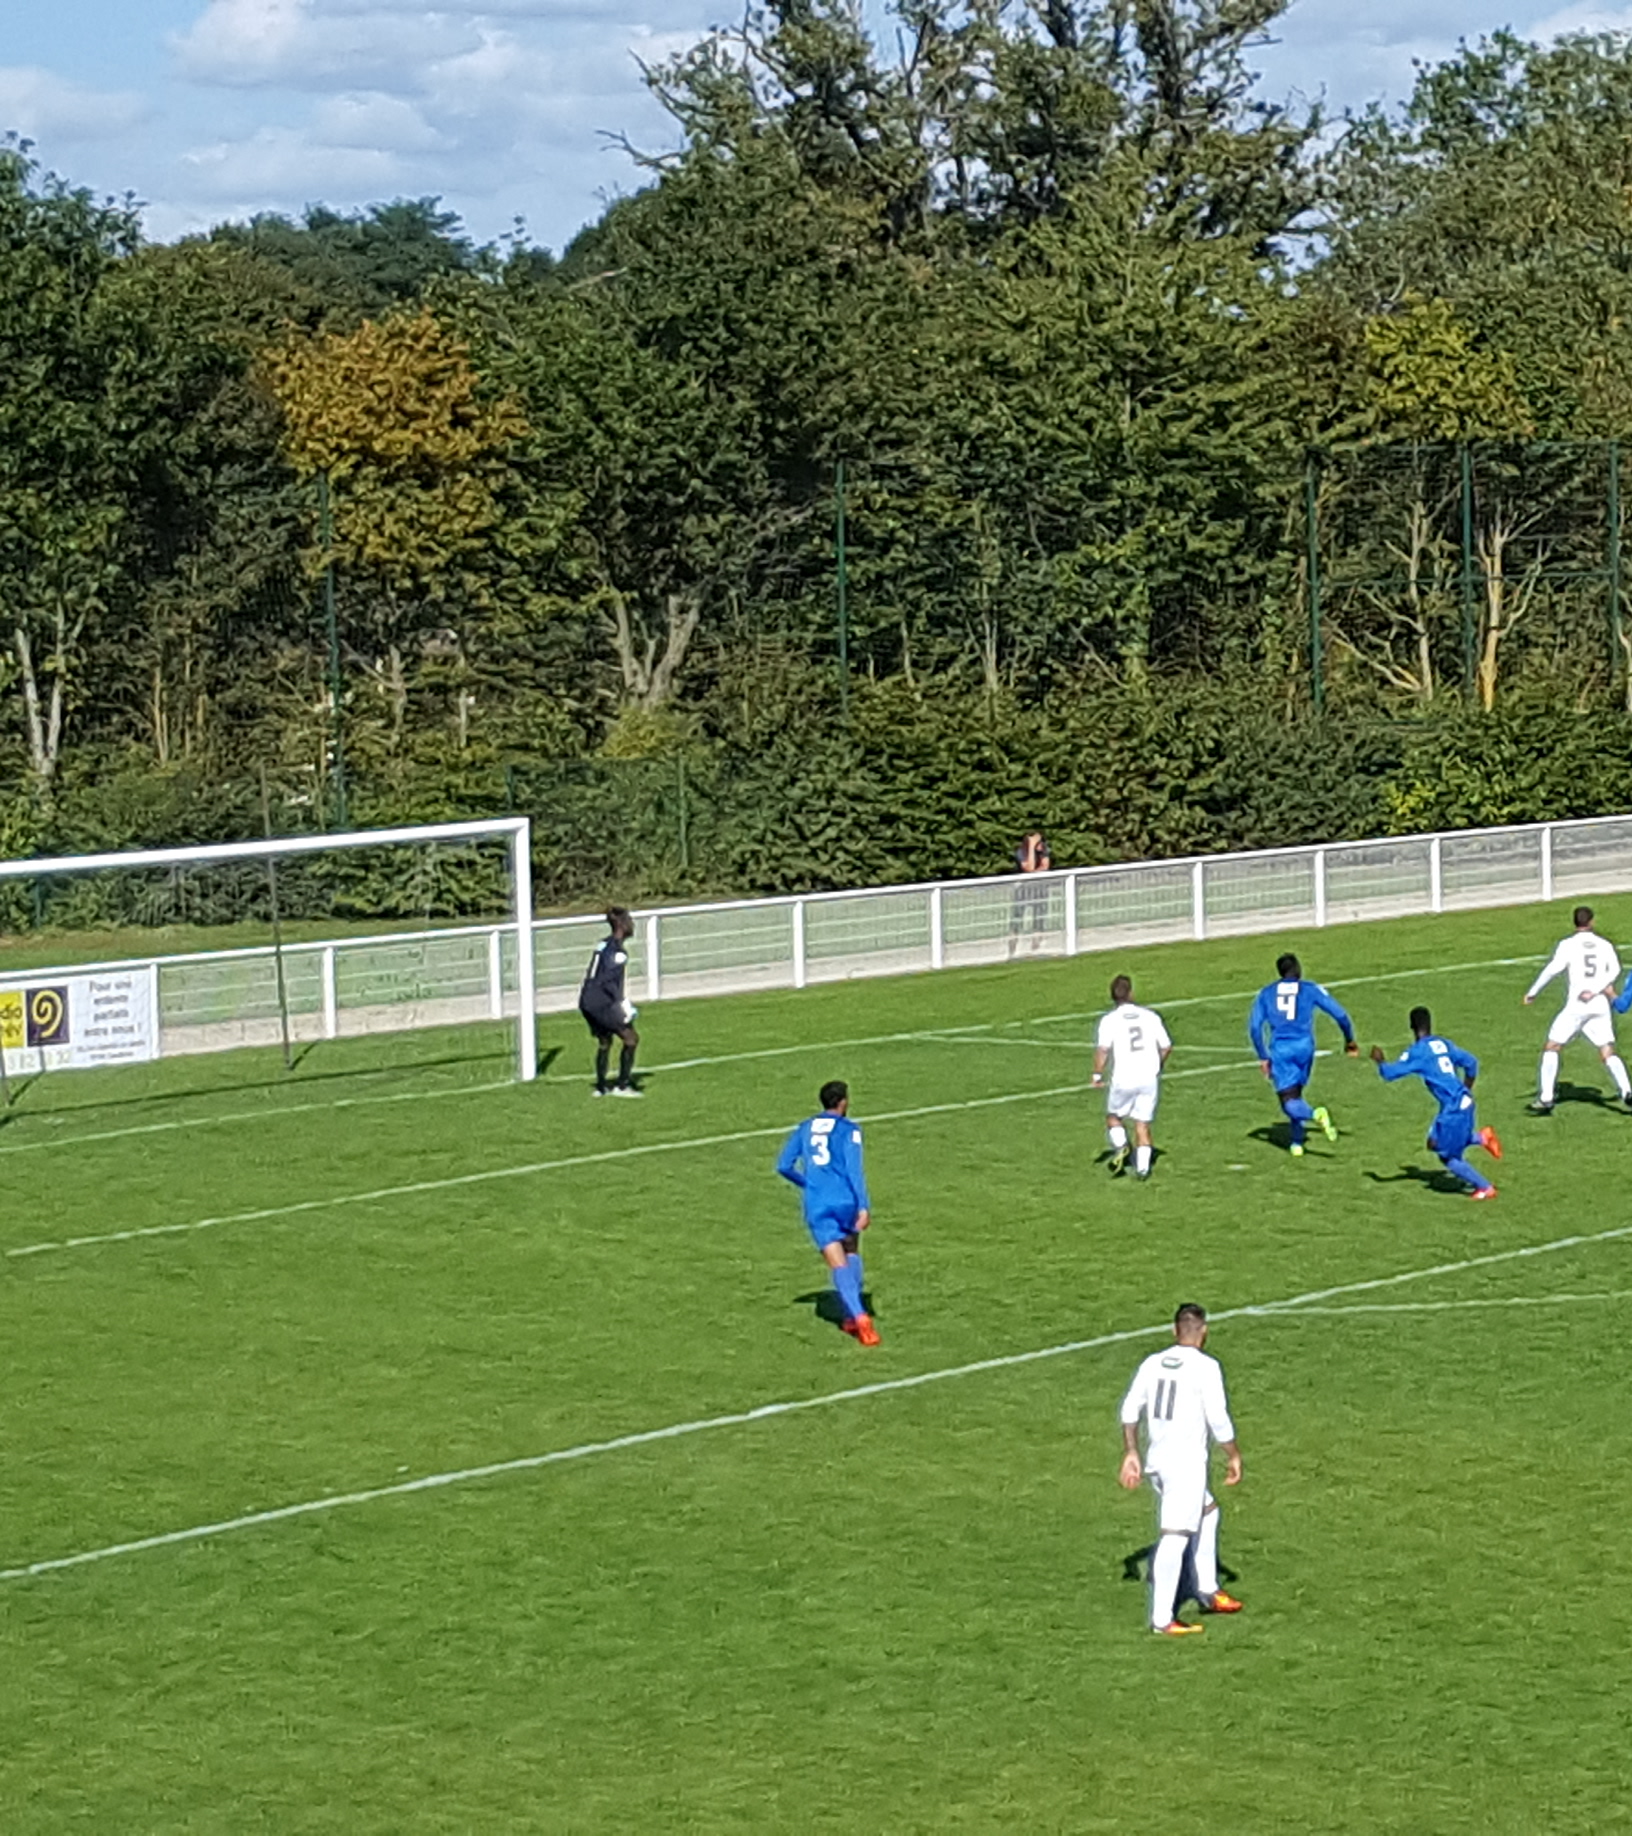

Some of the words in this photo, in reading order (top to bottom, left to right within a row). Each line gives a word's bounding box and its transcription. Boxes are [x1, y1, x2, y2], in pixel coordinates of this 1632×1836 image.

[1584, 954, 1597, 978] 5
[1277, 995, 1297, 1021] 4
[1128, 1026, 1145, 1052] 2
[810, 1134, 831, 1166] 3
[1153, 1378, 1177, 1421] 11
